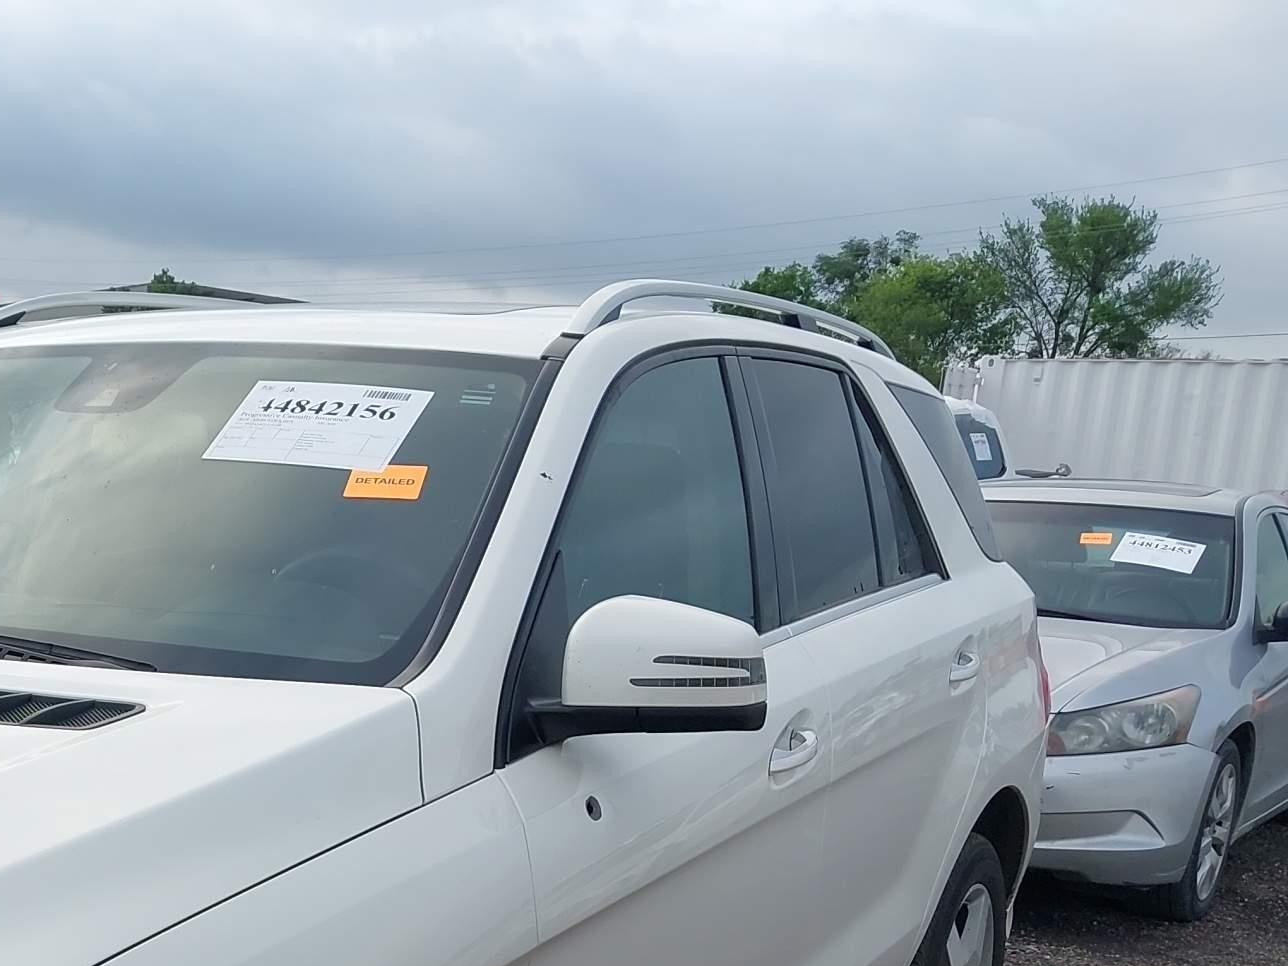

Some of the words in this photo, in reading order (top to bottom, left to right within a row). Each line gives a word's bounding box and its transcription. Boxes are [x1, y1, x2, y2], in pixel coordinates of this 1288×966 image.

[260, 398, 399, 420] 44842156
[355, 477, 415, 485] DETAILED
[1129, 540, 1192, 554] 44812453
